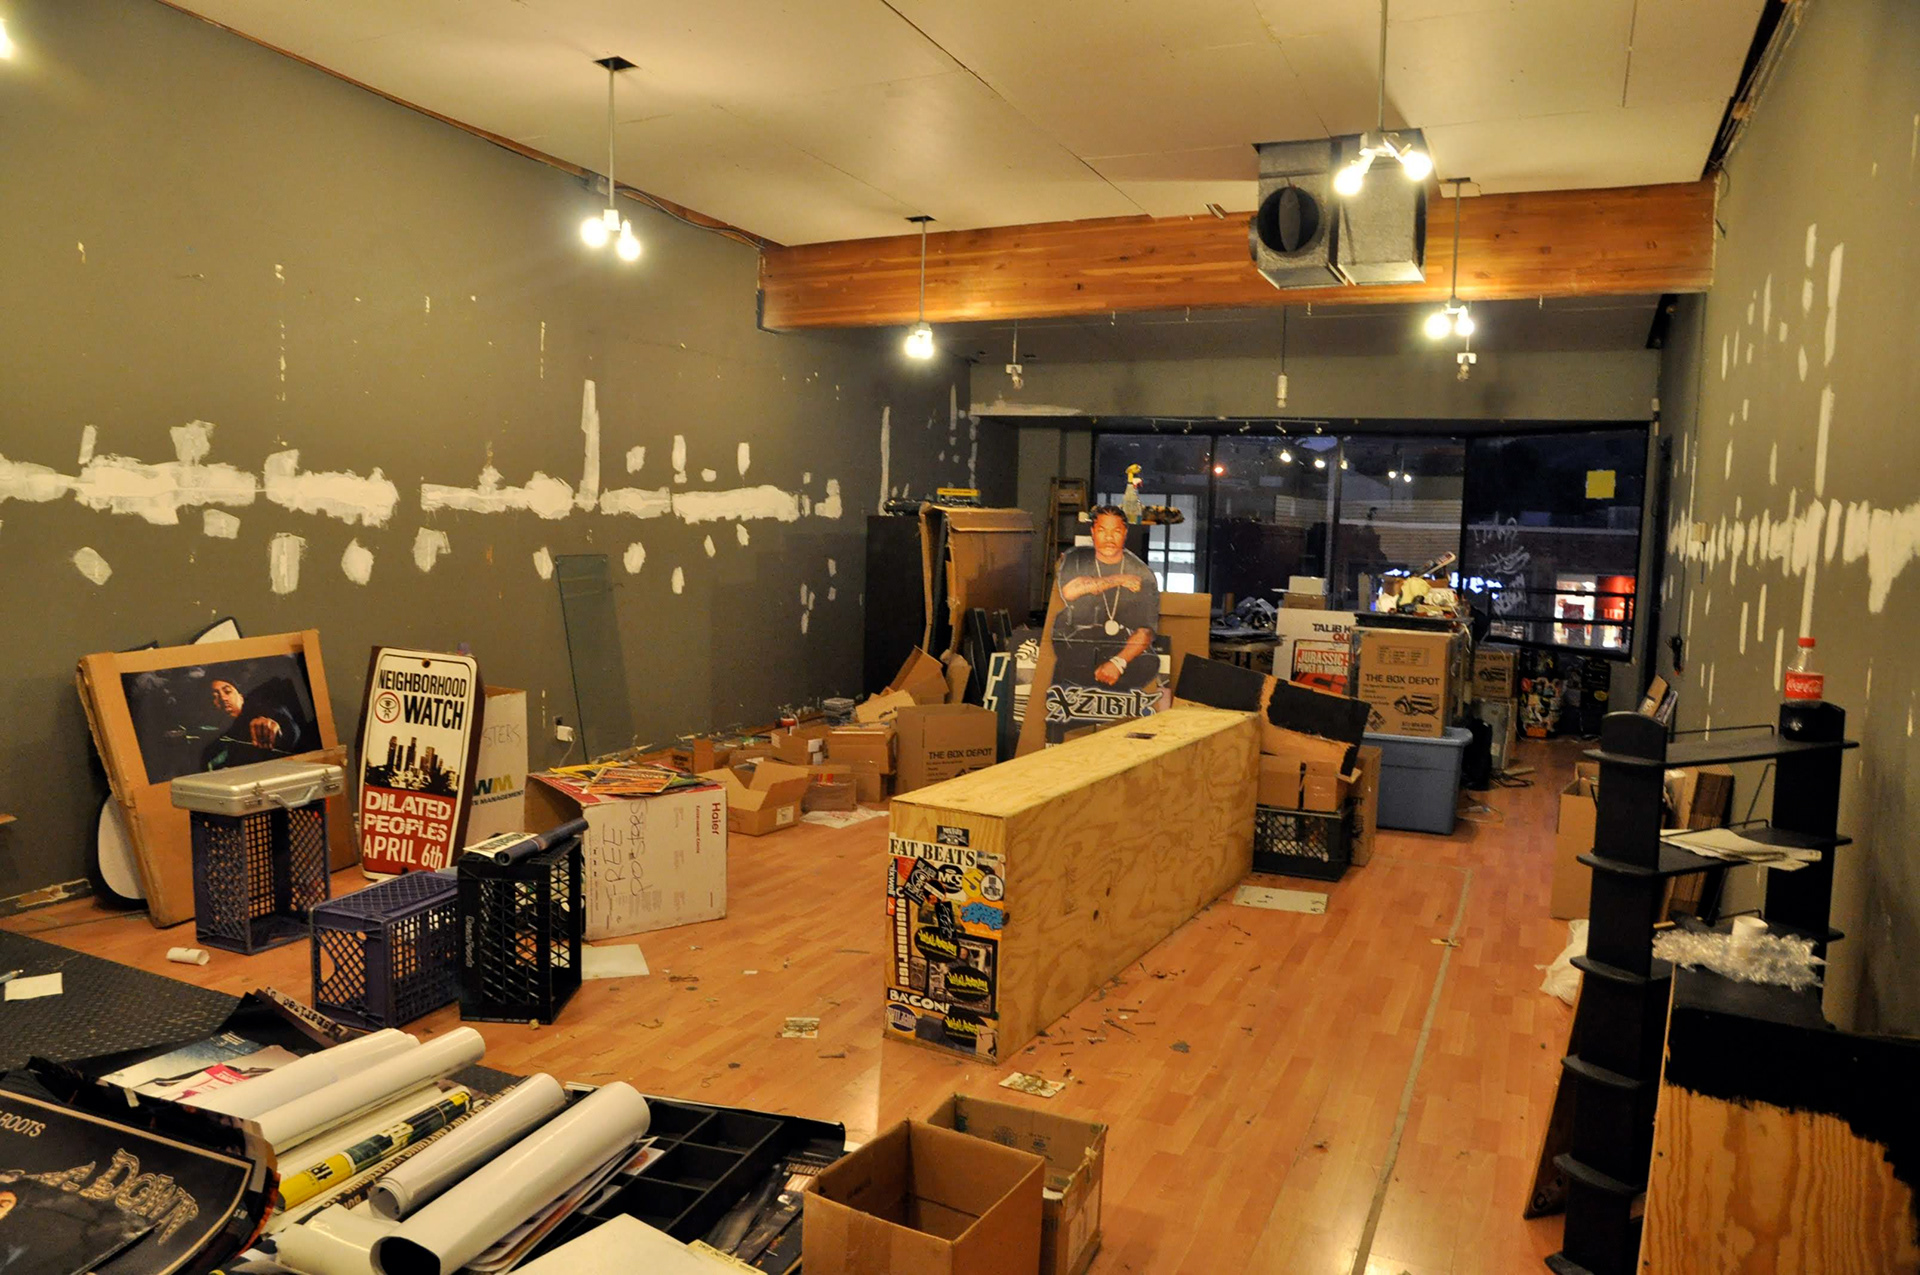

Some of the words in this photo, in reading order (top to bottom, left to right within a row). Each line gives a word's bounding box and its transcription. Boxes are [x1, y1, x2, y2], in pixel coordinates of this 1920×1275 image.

[1298, 651, 1344, 666] JURASSIC
[378, 669, 467, 698] NEIGHBORHOOD
[1365, 674, 1383, 682] THE
[1386, 675, 1406, 684] BOX
[1408, 676, 1440, 685] DEPOT
[403, 694, 465, 730] WATCH
[928, 751, 945, 760] THE
[947, 750, 965, 759] BOX
[966, 747, 992, 757] DEPOT
[364, 790, 451, 820] DILATED
[480, 789, 524, 805] MANAGEMENT
[363, 812, 448, 842] PEOPLES
[711, 802, 721, 835] Haier
[363, 834, 417, 864] APRIL
[421, 843, 443, 870] 6th
[889, 838, 919, 857] FAT
[922, 844, 977, 867] BEATS
[1, 1111, 47, 1138] ROOTS
